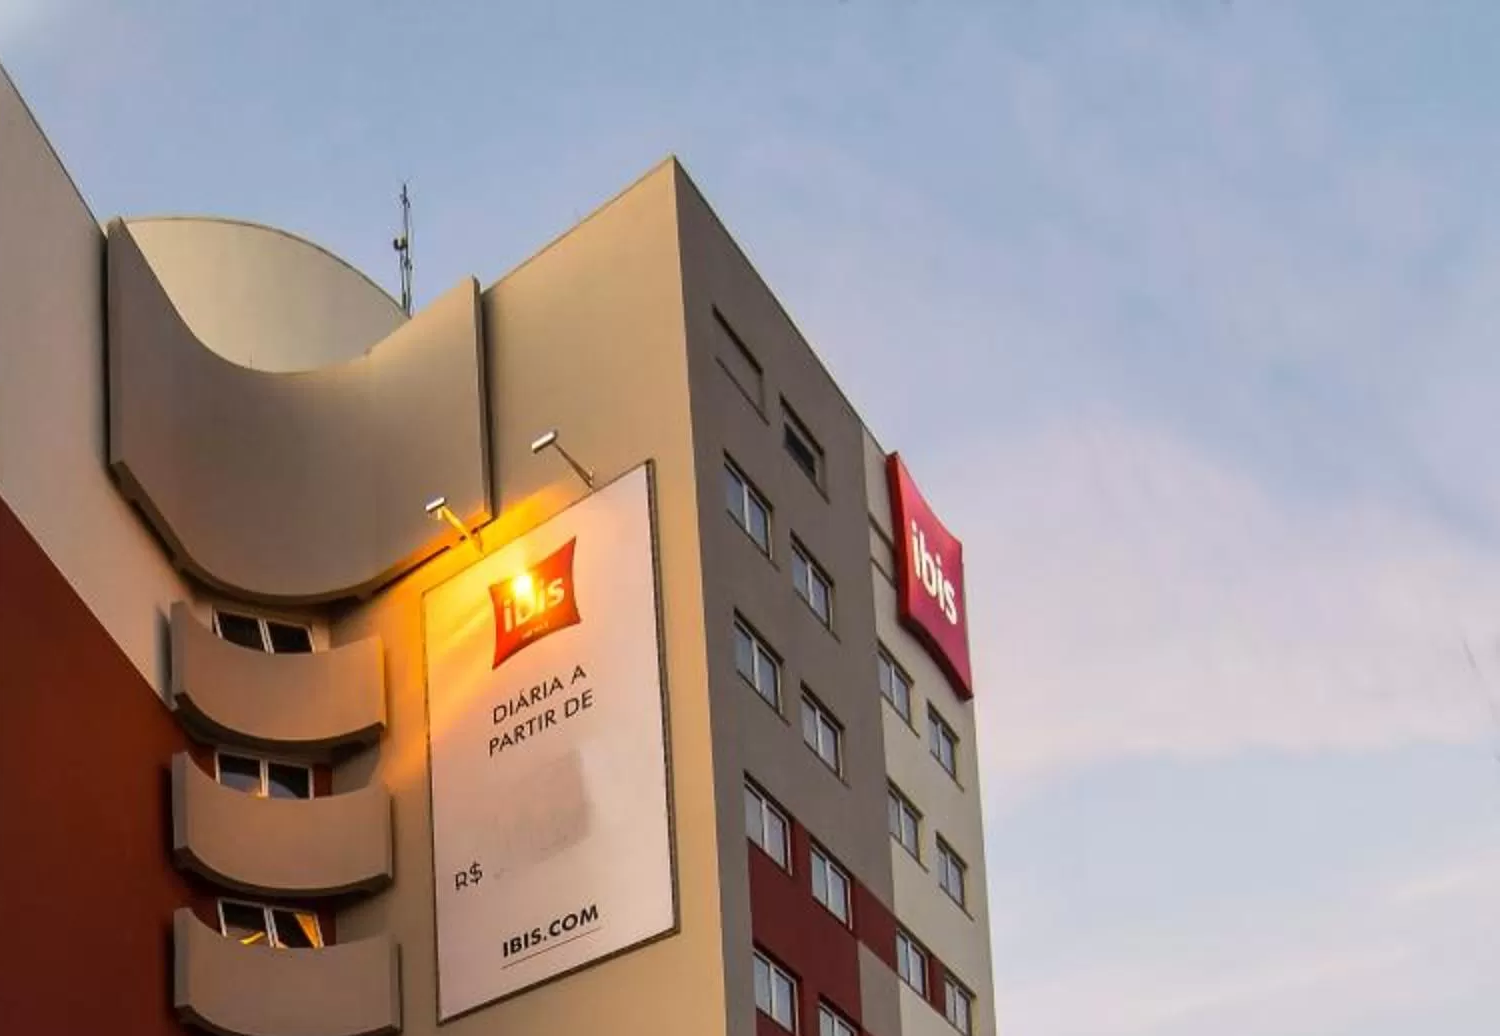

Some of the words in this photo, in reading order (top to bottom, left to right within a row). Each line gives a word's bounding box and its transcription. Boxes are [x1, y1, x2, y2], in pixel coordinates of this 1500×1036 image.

[911, 519, 958, 625] ibis
[503, 576, 565, 633] ibis
[489, 709, 557, 758] PARTIR
[564, 688, 593, 718] DE
[493, 676, 564, 725] DIÁRIA
[571, 665, 587, 685] A
[455, 861, 483, 891] R$
[503, 904, 599, 957] IBIS.COM
